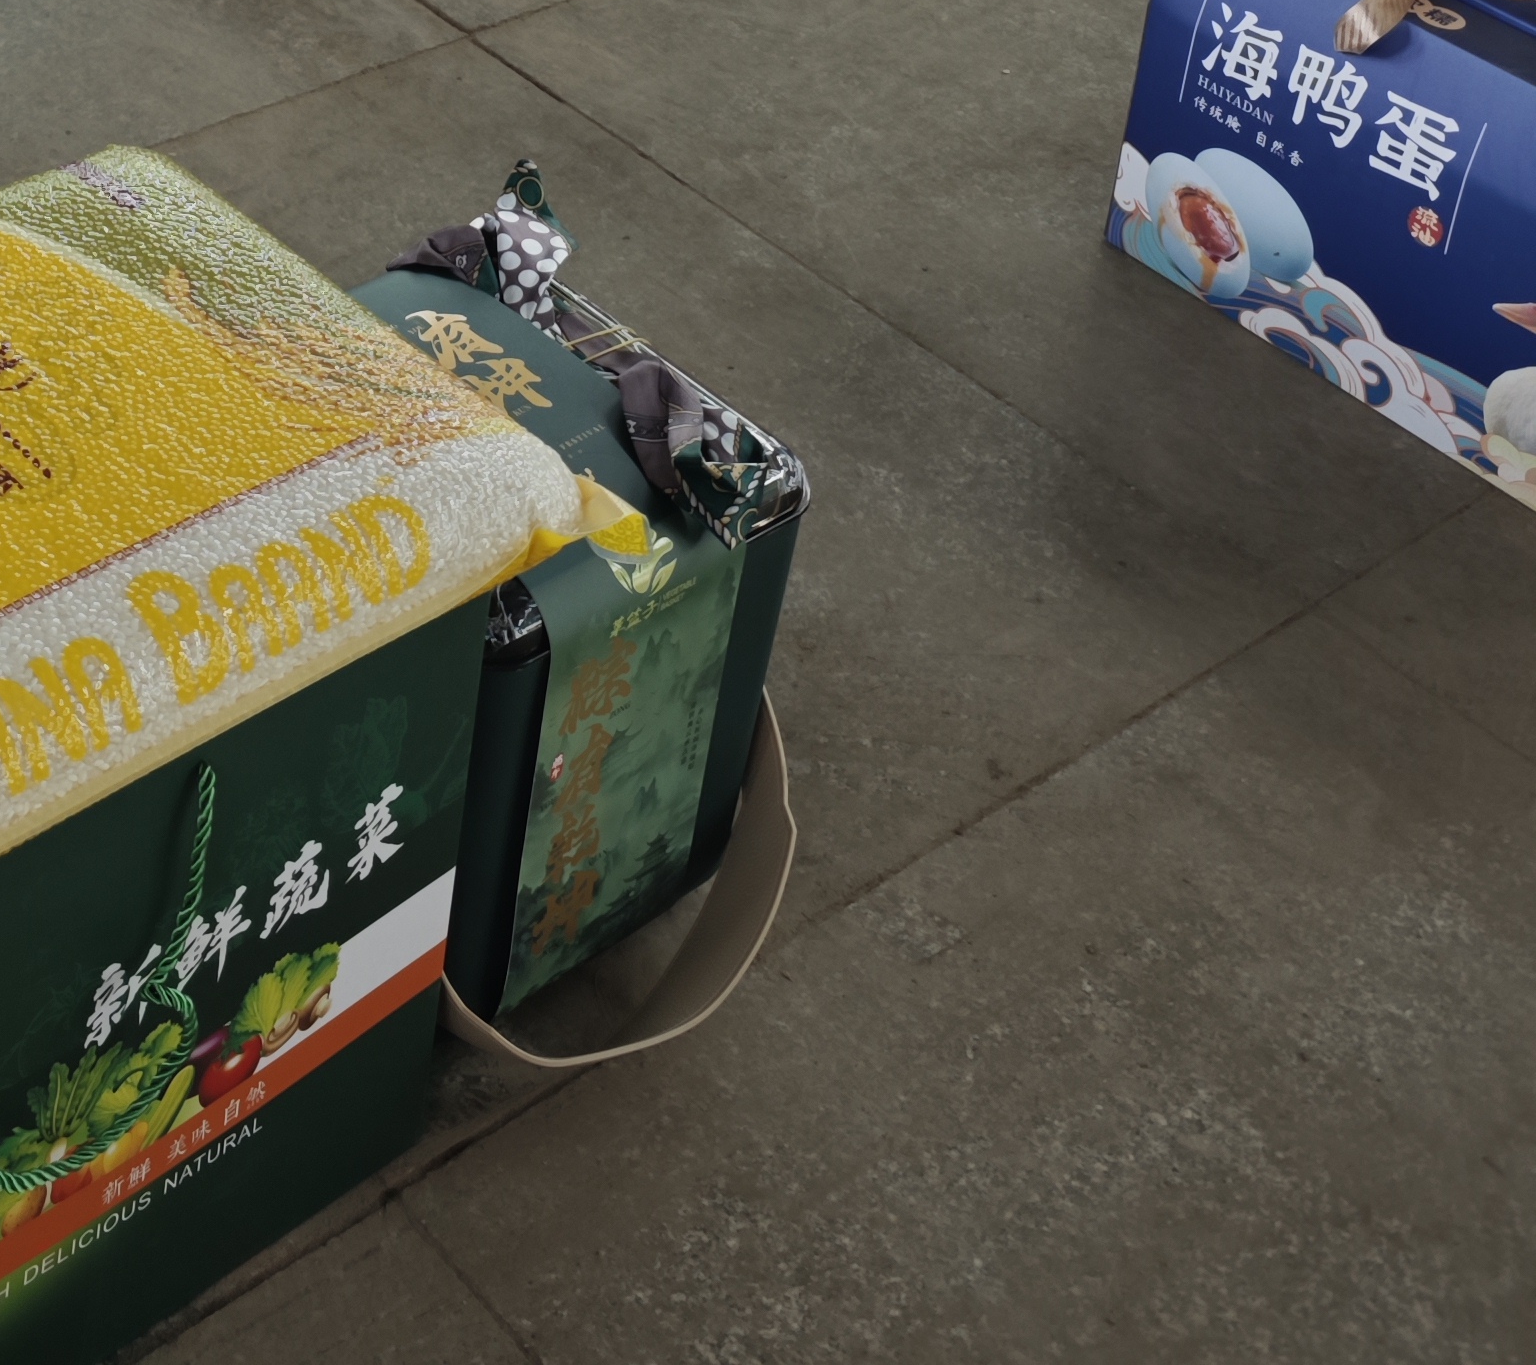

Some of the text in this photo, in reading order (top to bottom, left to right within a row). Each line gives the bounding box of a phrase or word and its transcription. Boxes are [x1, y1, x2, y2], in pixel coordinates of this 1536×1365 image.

[1193, 94, 1305, 168] 传统腌 自然香
[1197, 73, 1275, 128] HAIYADAN
[1202, 1, 1461, 202] 海鸭蛋
[1412, 204, 1442, 248] 流油
[125, 495, 432, 705] BRAND
[85, 781, 407, 1050] 新鲜蔬菜
[22, 1191, 153, 1287] DELICIOUS
[163, 1116, 264, 1196] NATURAL
[101, 1080, 270, 1207] 新鲜 美味 自然
